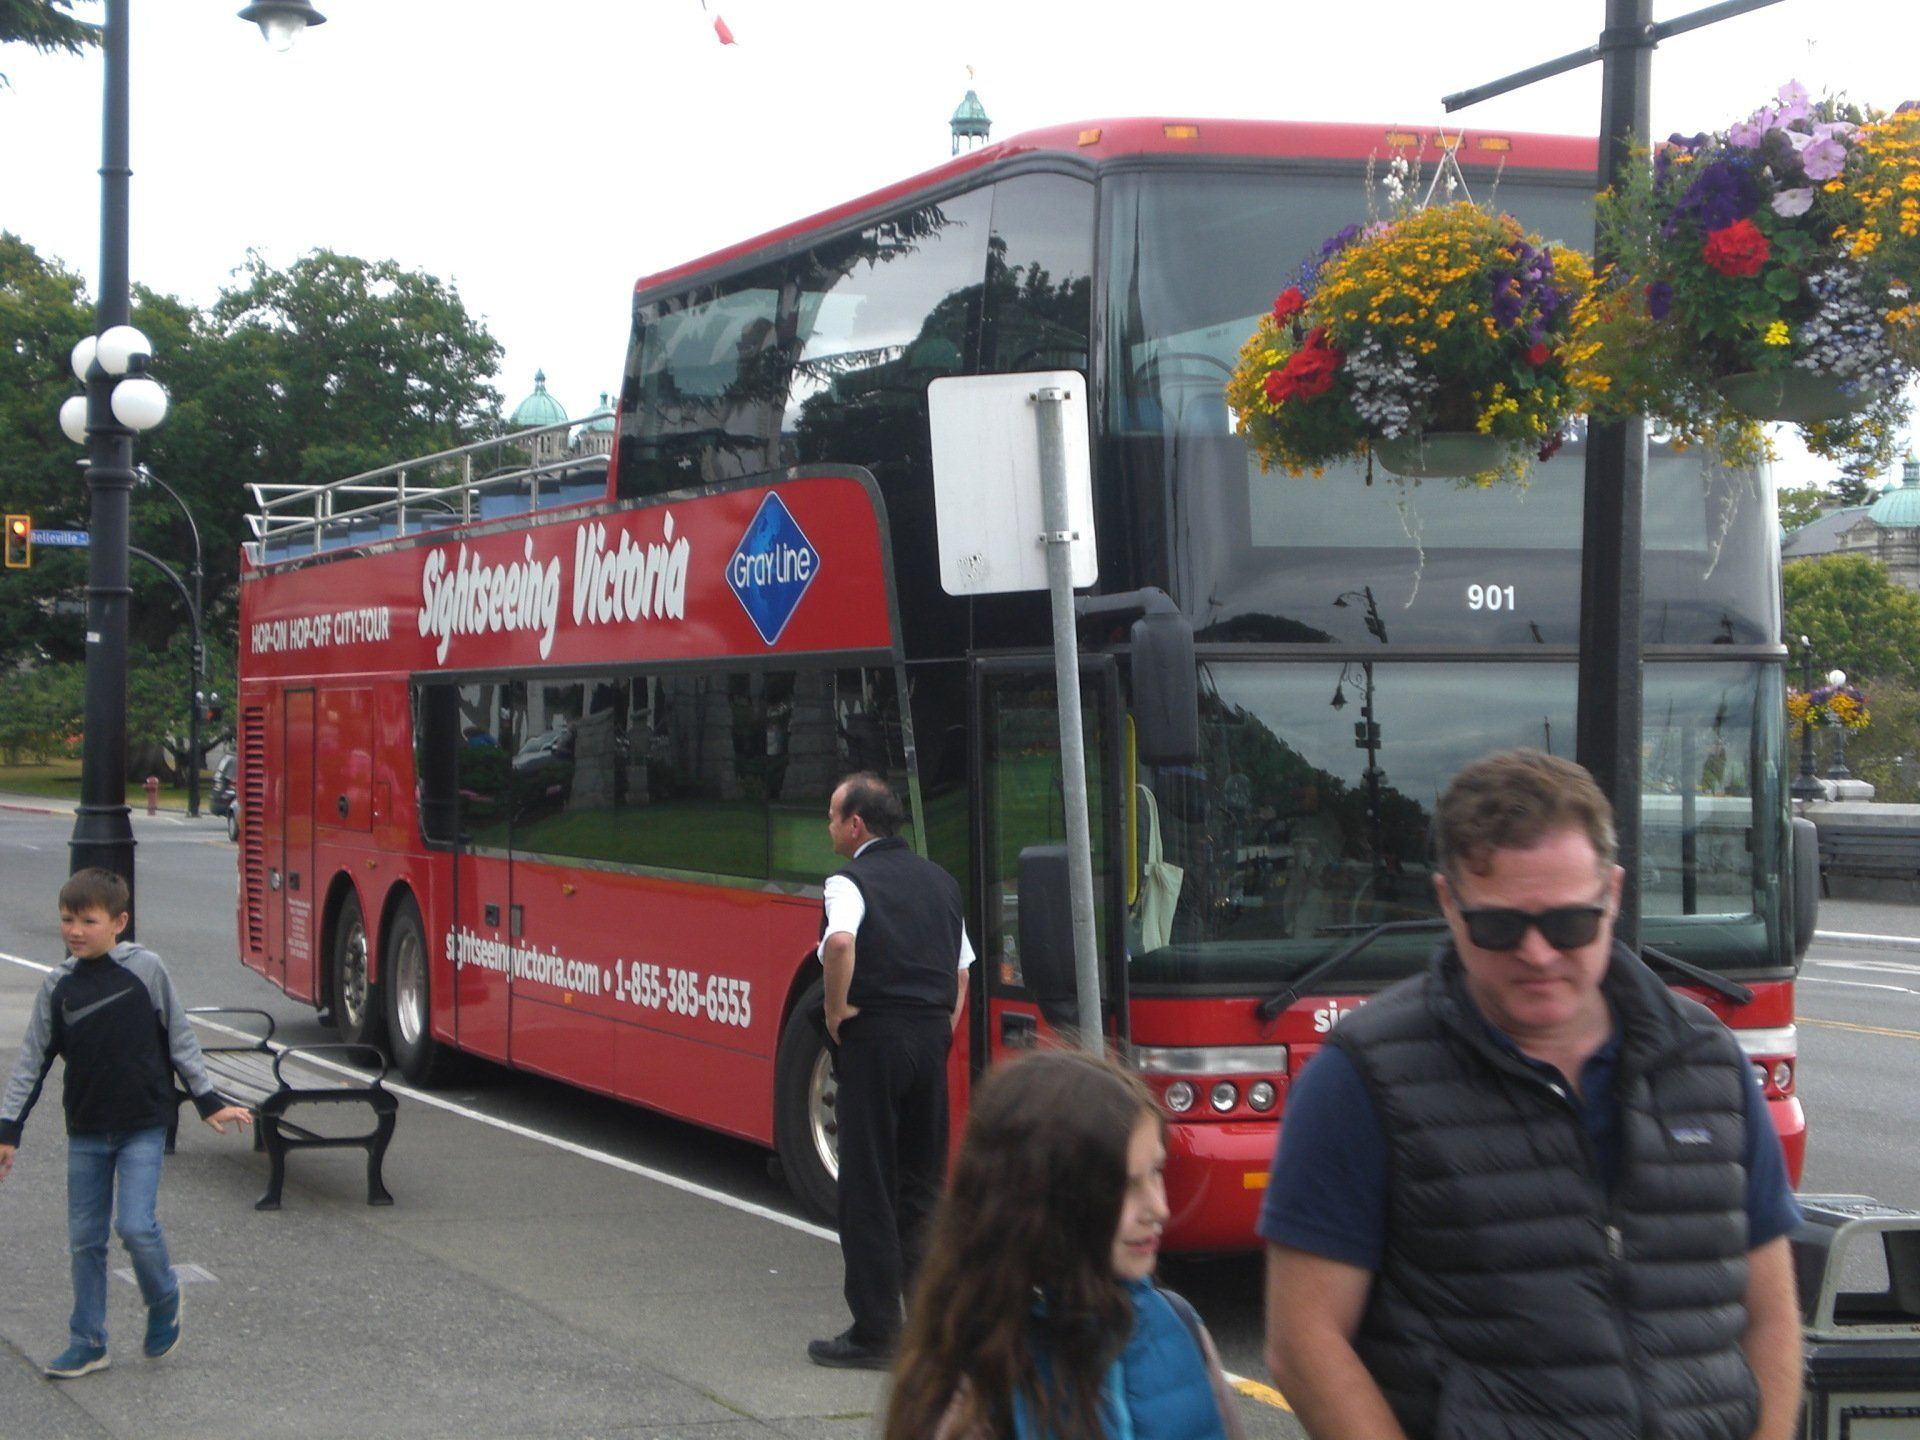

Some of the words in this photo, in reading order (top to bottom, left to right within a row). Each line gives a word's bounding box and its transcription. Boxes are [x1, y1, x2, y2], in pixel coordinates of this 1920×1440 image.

[30, 532, 78, 544] Belleville
[418, 534, 560, 666] Sightseeing
[572, 511, 691, 627] Victoria
[1467, 584, 1516, 611] 901
[252, 620, 287, 654] HOP-ON
[289, 613, 332, 649] HOP-OFF
[334, 606, 390, 646] CITY-TOUR
[446, 925, 600, 996] sightseeingvictoria.com
[614, 958, 752, 1029] 1-855-385-6553
